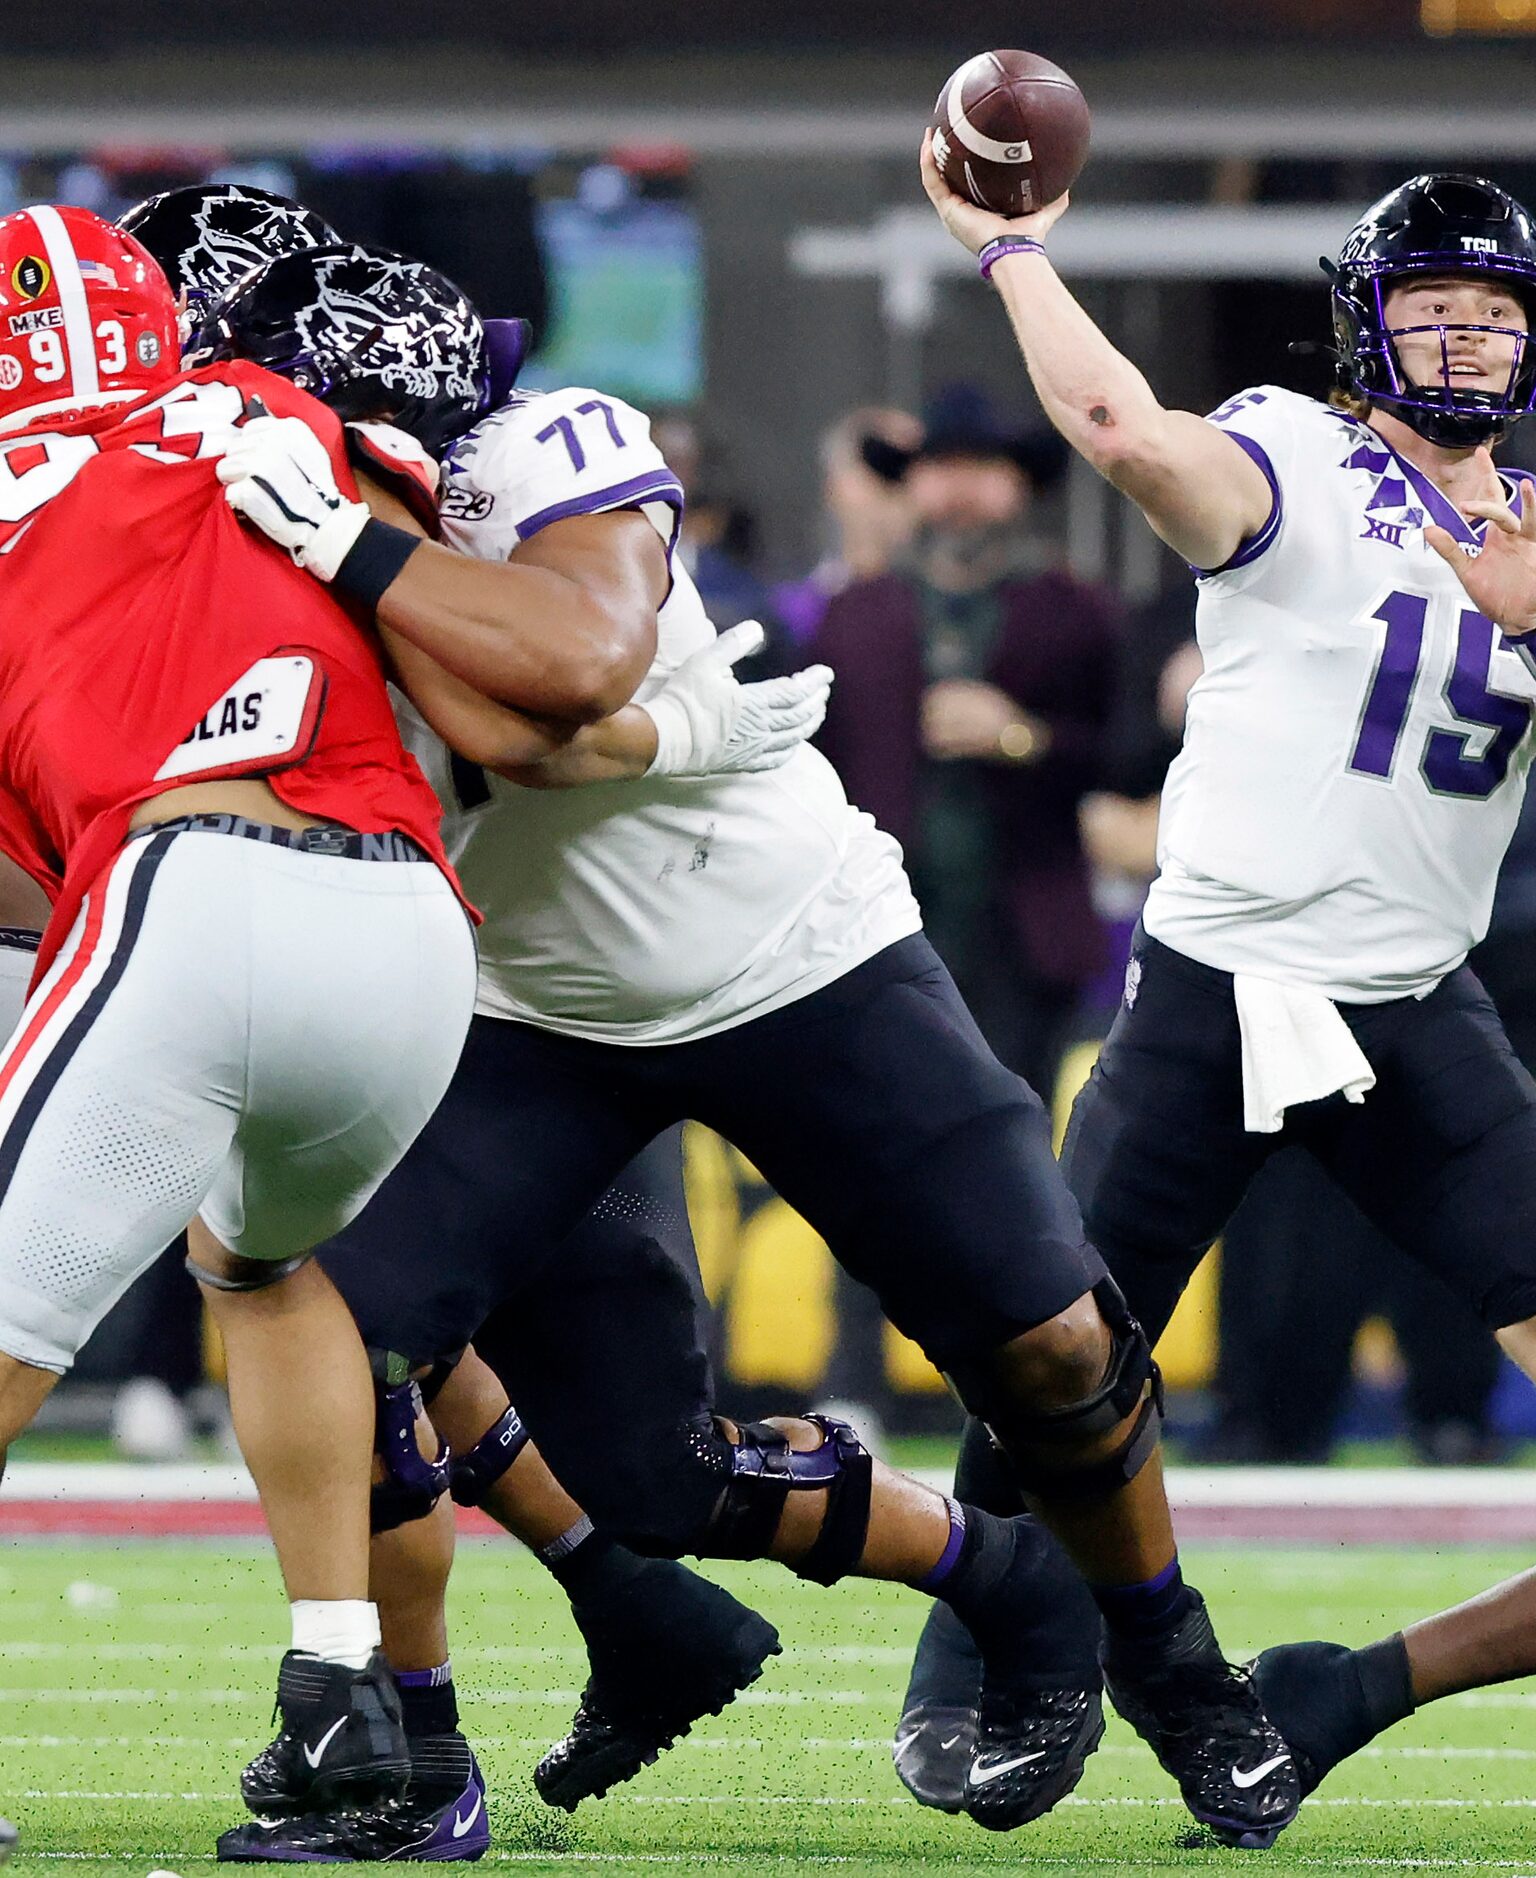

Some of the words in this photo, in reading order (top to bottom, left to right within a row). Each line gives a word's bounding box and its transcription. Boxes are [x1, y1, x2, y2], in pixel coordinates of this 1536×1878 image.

[1460, 236, 1498, 254] TCU
[534, 400, 627, 464] 77
[1359, 514, 1409, 550] XII
[1344, 584, 1536, 802] 15
